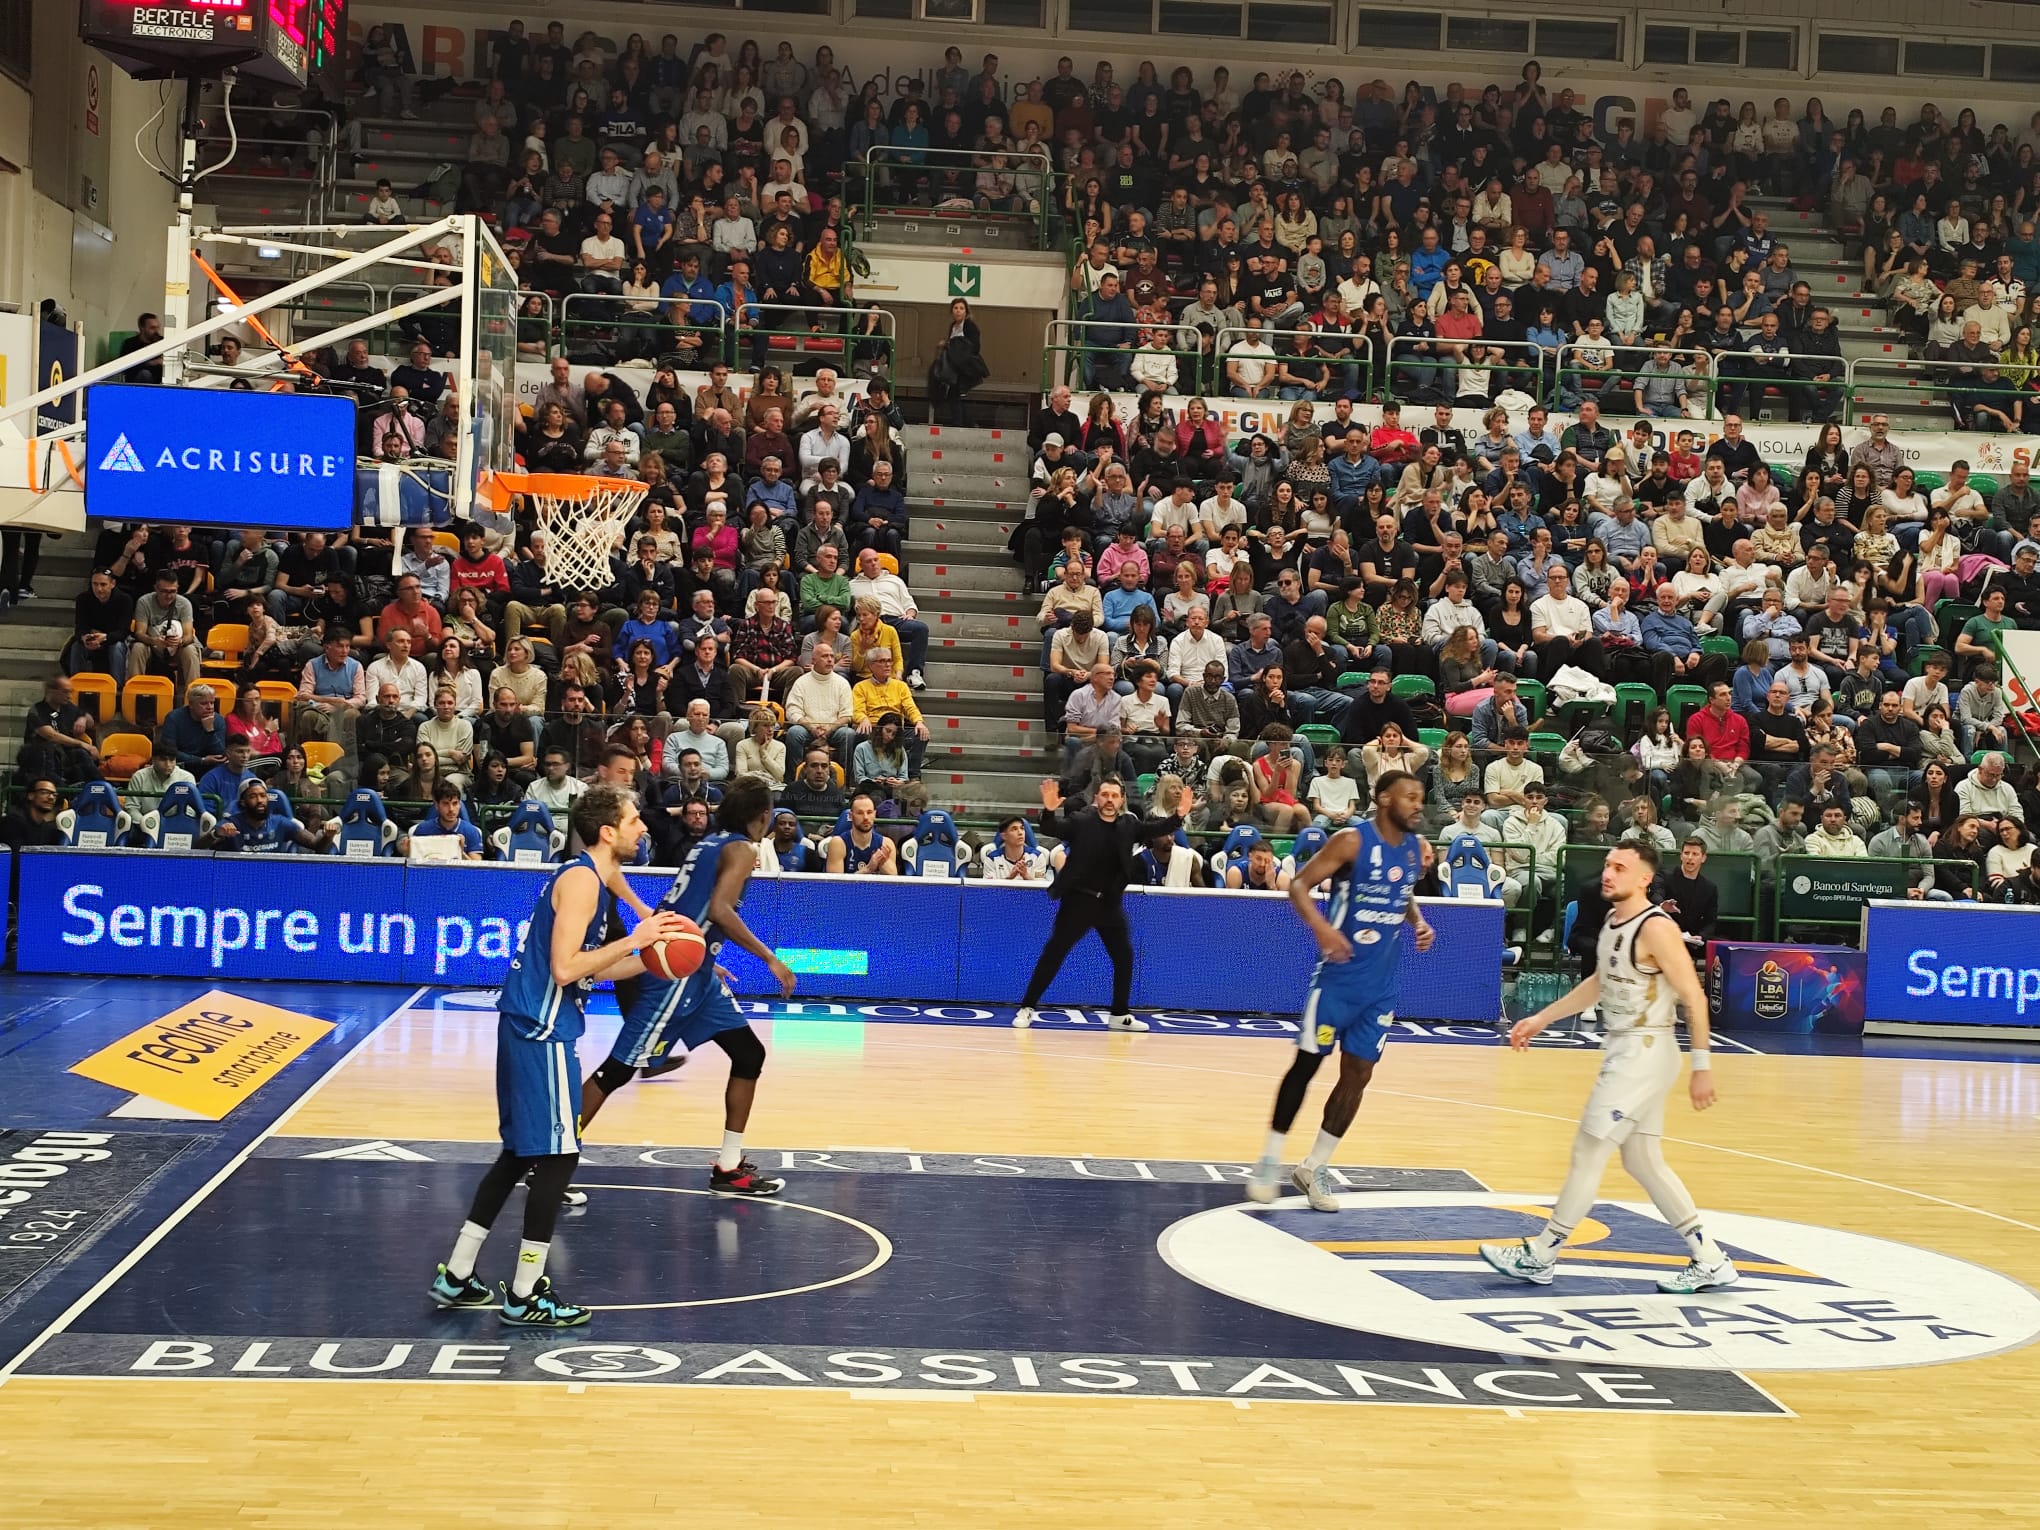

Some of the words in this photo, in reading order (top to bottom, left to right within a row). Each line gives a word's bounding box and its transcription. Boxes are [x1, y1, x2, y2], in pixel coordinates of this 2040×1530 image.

[133, 7, 214, 28] BERTELÈ
[132, 24, 213, 41] ELECTRONICS
[608, 123, 636, 136] FILA
[1264, 287, 1284, 298] VANS
[1759, 439, 1804, 456] ISOLA
[1370, 845, 1383, 867] 4
[1813, 880, 1841, 892] Banco
[1842, 881, 1850, 892] di
[1851, 882, 1893, 895] Sardegna
[1813, 893, 1833, 902] Gruppo
[1847, 895, 1862, 903] Banca
[61, 884, 319, 968] Sempre
[338, 911, 416, 955] un
[1760, 984, 1784, 995] LBA
[1906, 948, 2040, 1015] Semp
[740, 1000, 994, 1020] anco
[126, 1010, 255, 1075] realme
[212, 1030, 301, 1088] smartphone
[1463, 1299, 1938, 1334] REALE
[1519, 1321, 1996, 1354] MUTUA
[128, 1340, 512, 1375] BLUE
[692, 1347, 1674, 1405] ASSISTANCE
